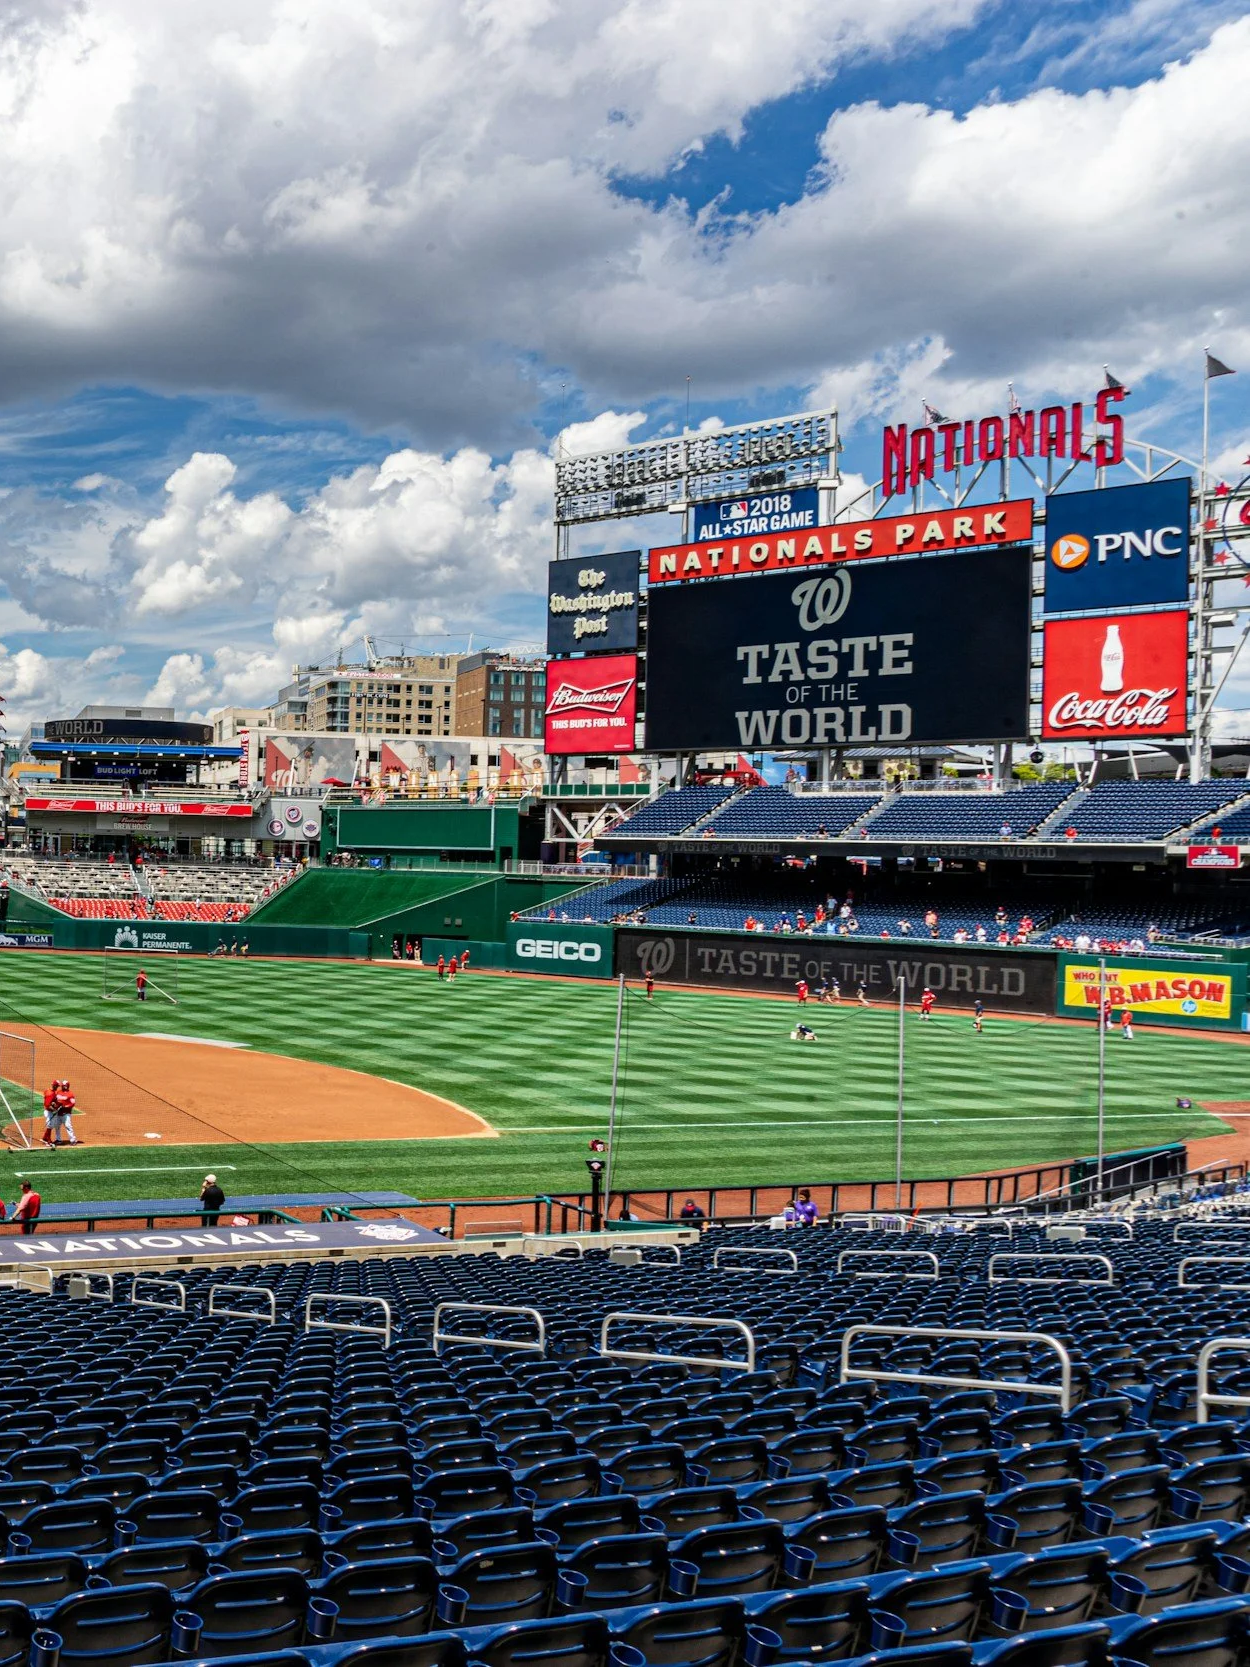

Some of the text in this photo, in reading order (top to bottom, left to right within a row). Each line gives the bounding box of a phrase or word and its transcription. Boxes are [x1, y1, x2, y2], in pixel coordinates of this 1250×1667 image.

[882, 386, 1126, 498] NATIONALS
[749, 496, 791, 516] 2018
[699, 509, 814, 541] ALL STAR GAME
[659, 511, 1006, 574] NATIONALS PARK
[1093, 526, 1183, 562] PNC
[577, 568, 607, 589] The
[549, 590, 635, 613] Washington
[572, 615, 609, 639] Post
[736, 633, 914, 684] TASTE
[553, 689, 625, 705] Budweiser
[785, 682, 859, 704] OF THE
[1048, 687, 1178, 730] Coca-Cola
[55, 720, 104, 736] WORLD
[551, 716, 628, 729] THIS BUD'S FOR YOU.
[735, 703, 912, 746] WORLD
[113, 767, 136, 775] LIGHT
[138, 768, 158, 776] LOFT
[239, 762, 248, 786] STORE
[95, 800, 115, 811] THIS
[116, 801, 143, 812] BUD'S
[144, 802, 161, 812] FOR
[163, 803, 183, 813] YOU.
[113, 822, 153, 831] BREW HOUSE
[673, 842, 710, 852] TASTE
[738, 842, 780, 853] WORLD
[922, 845, 1057, 858] TASTE OF THE WORLD
[25, 935, 49, 943] MGM
[142, 932, 167, 940] KAISER
[515, 938, 601, 962] GEICO
[697, 948, 800, 980] TASTE
[804, 960, 833, 979] OF
[839, 962, 882, 984] THE
[886, 959, 1025, 997] WORLD
[1072, 972, 1096, 981] WHO
[14, 1230, 321, 1255] NATIONALS
